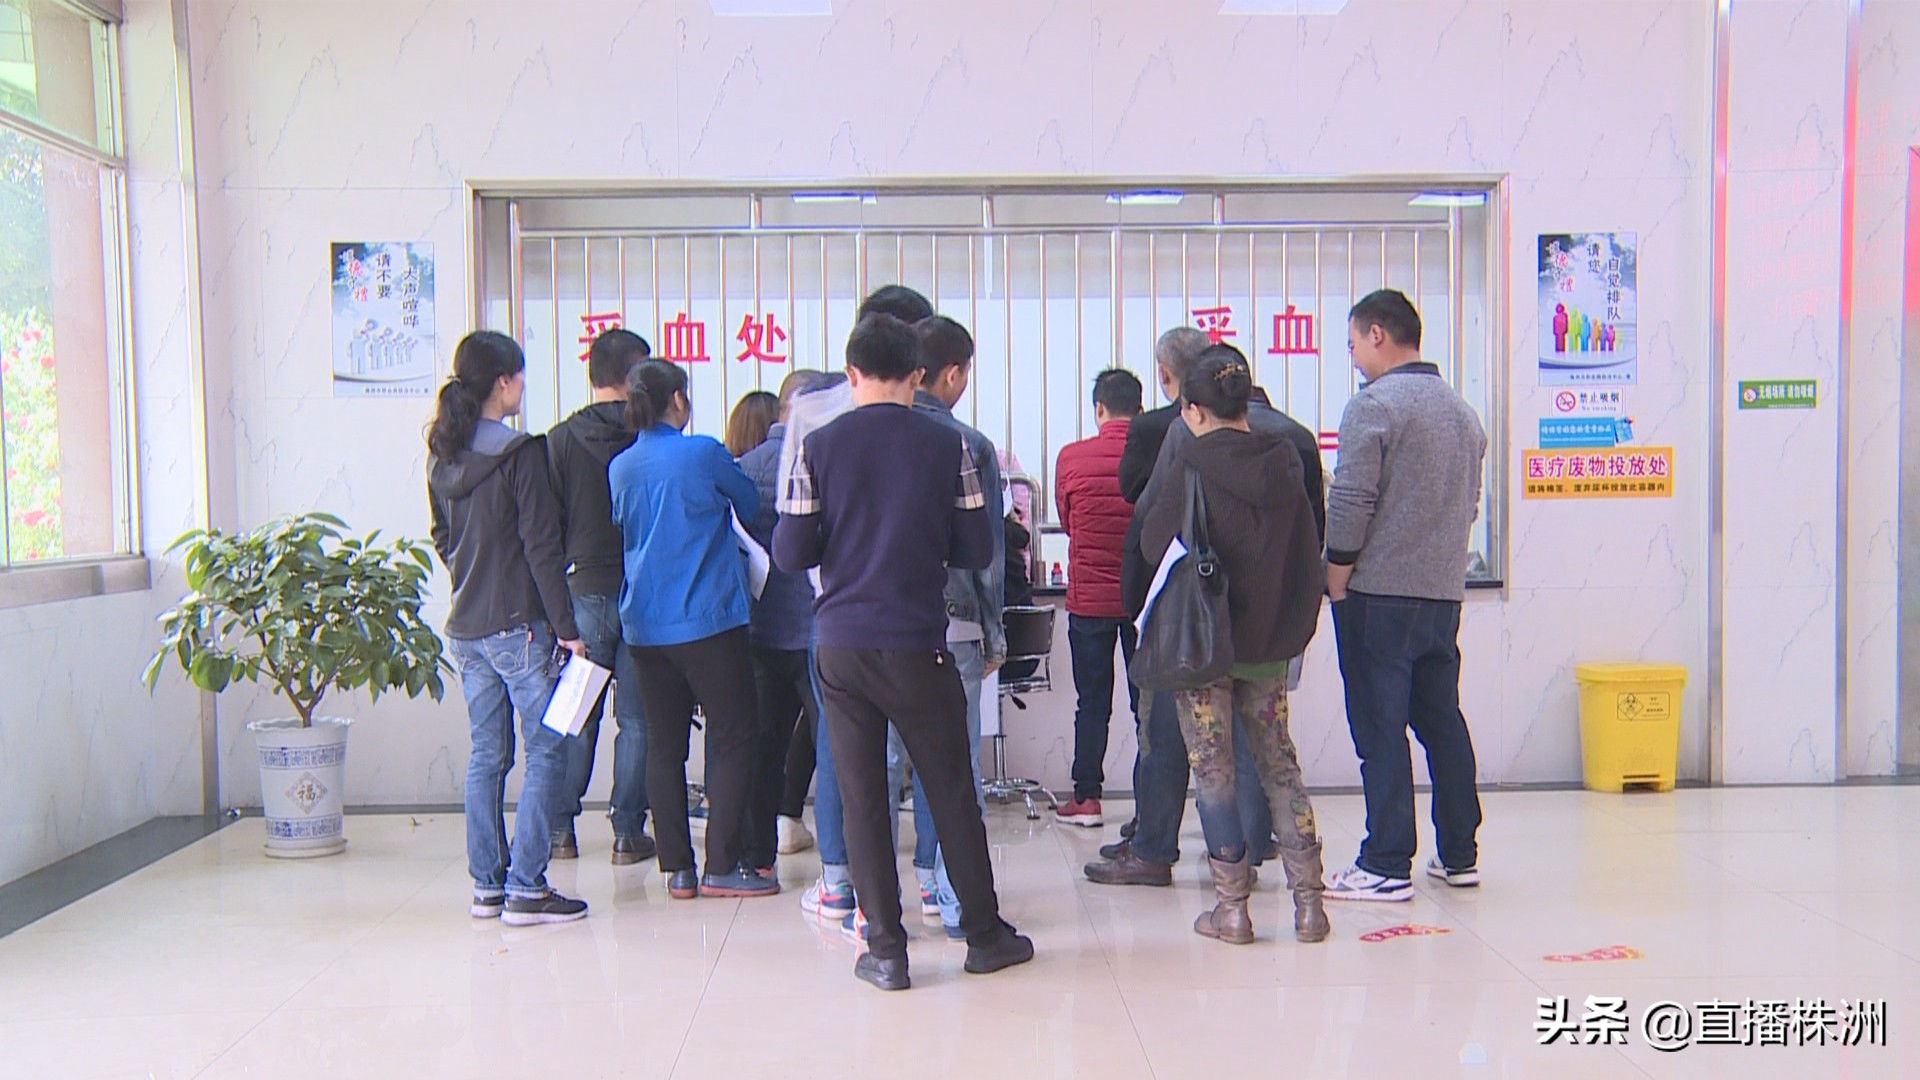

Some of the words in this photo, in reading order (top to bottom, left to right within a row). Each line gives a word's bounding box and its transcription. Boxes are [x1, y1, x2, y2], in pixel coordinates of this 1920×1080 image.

[376, 253, 392, 299] 请不要
[1587, 242, 1601, 274] 请您
[402, 266, 420, 328] 大声喧哗
[1607, 258, 1621, 320] 自觉排队
[1579, 392, 1620, 403] 禁止吸烟
[1528, 456, 1666, 478] 医疗废物投放处
